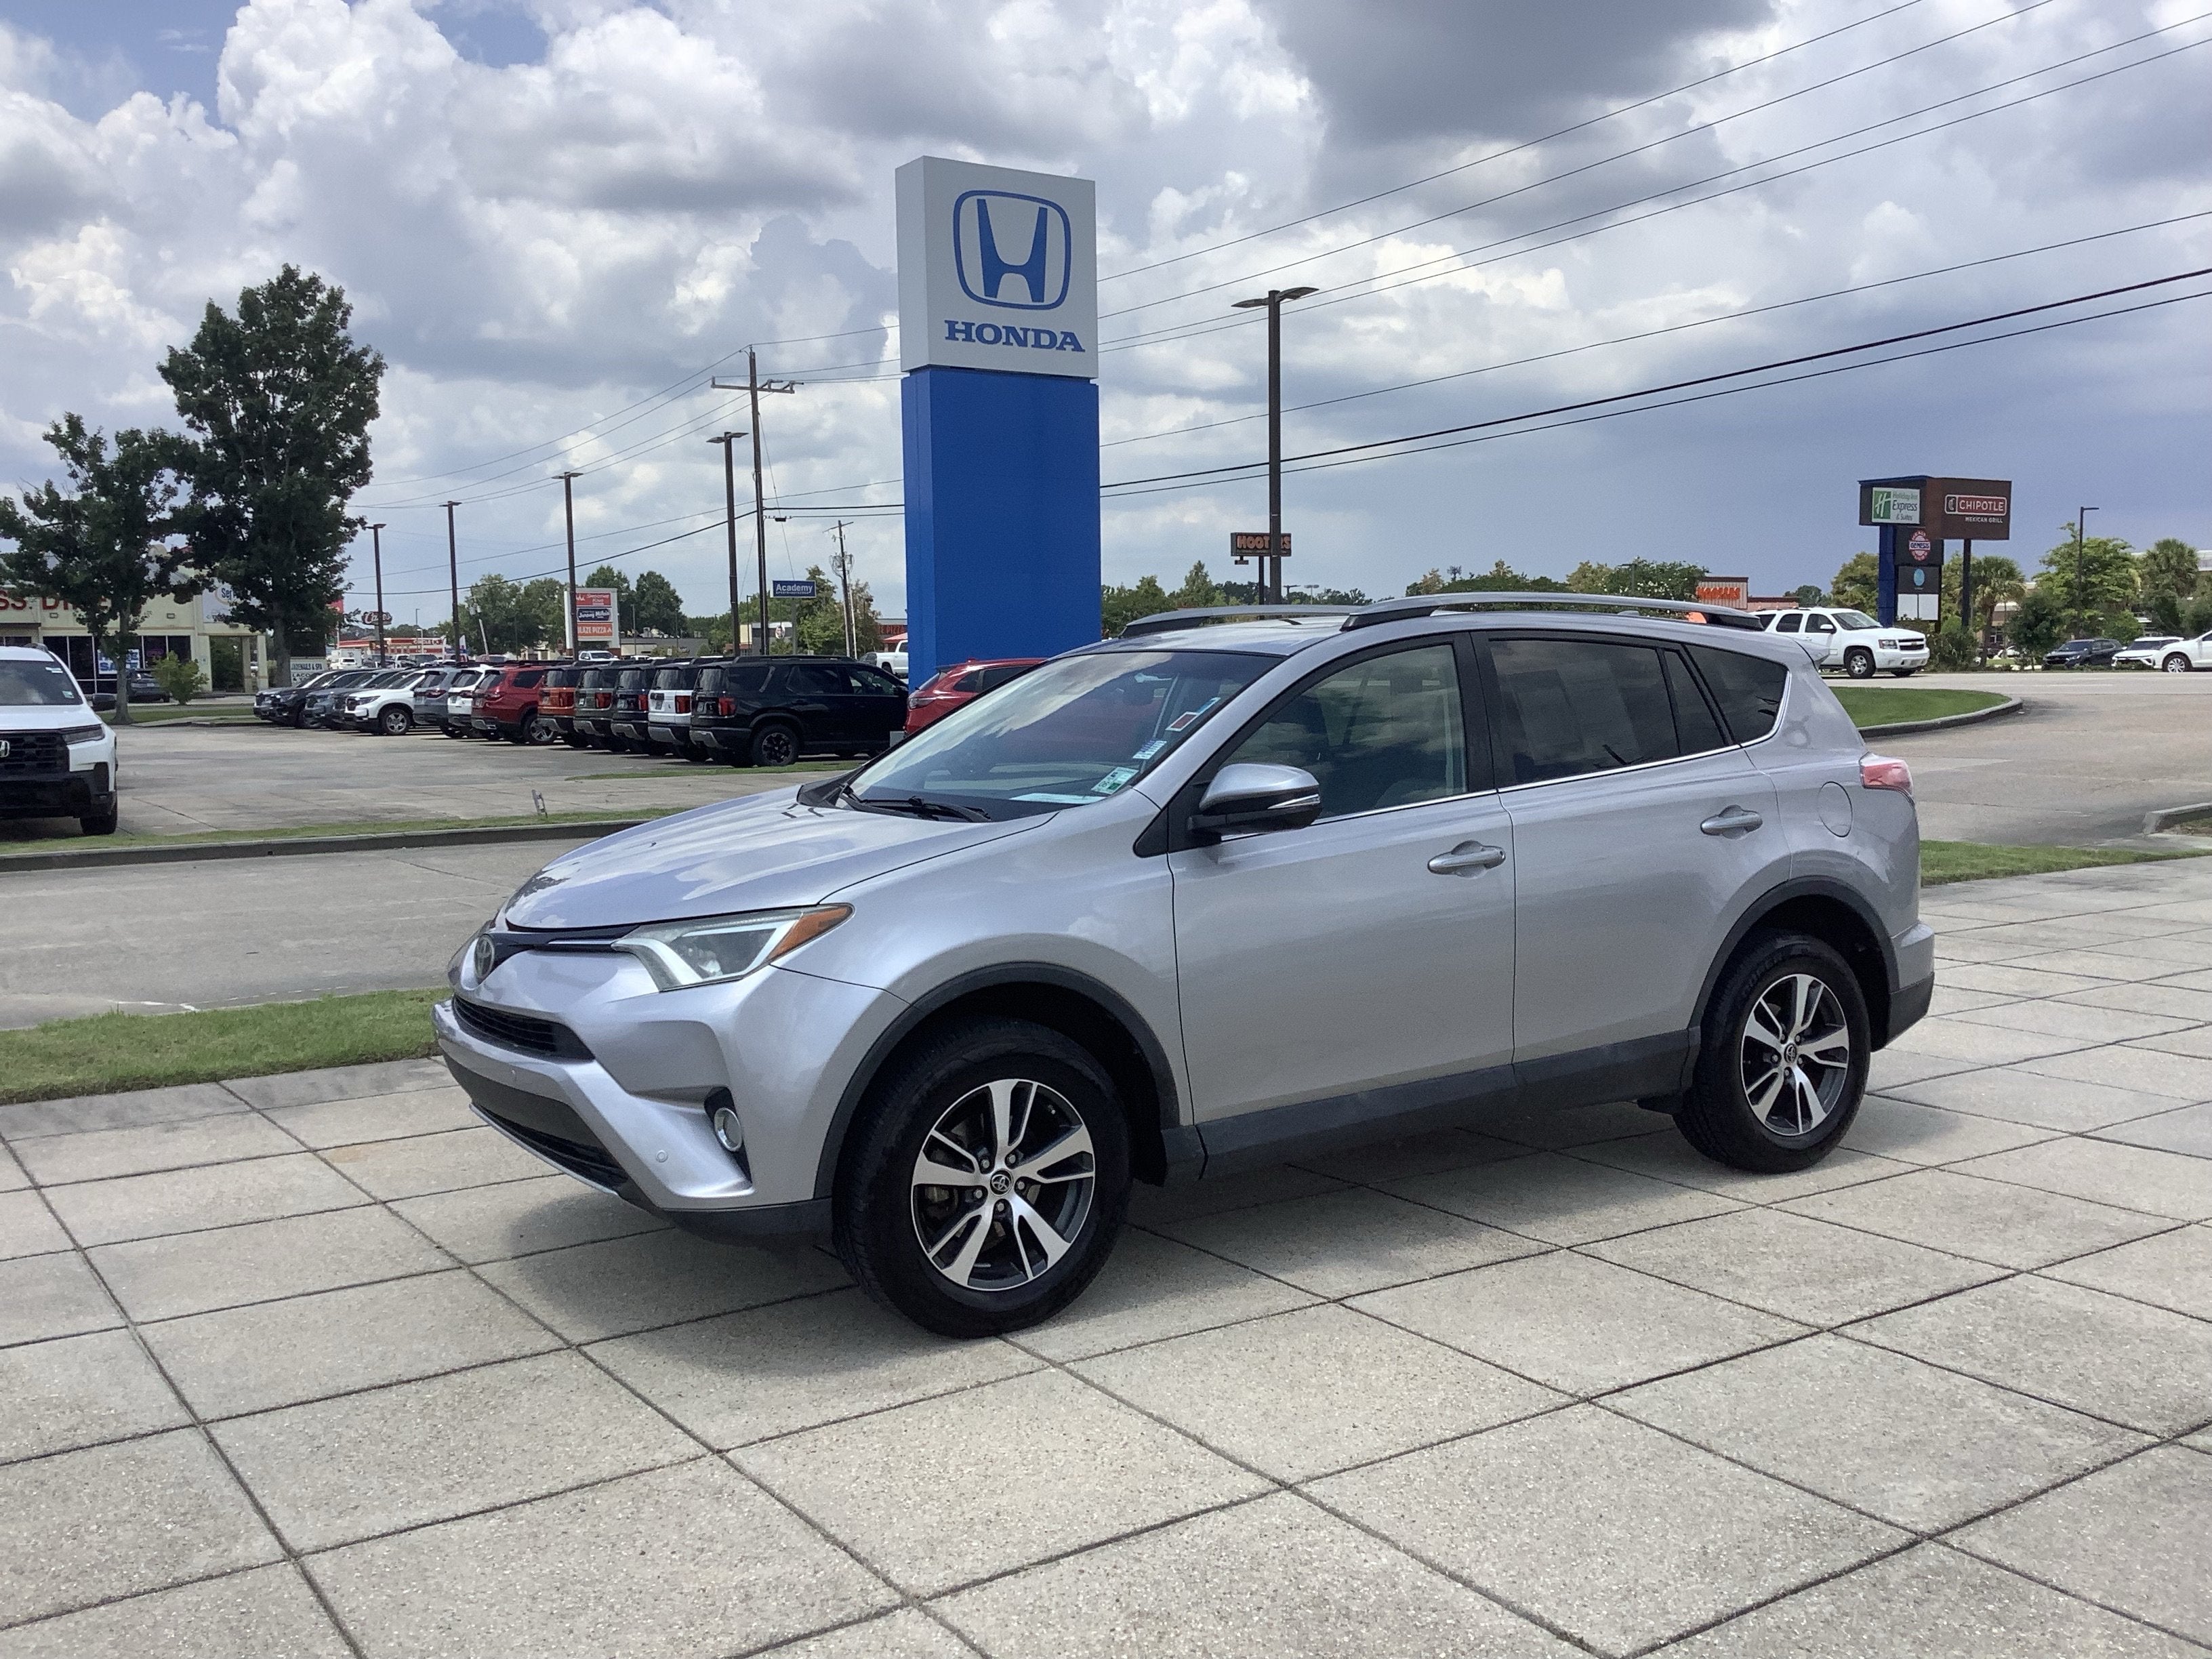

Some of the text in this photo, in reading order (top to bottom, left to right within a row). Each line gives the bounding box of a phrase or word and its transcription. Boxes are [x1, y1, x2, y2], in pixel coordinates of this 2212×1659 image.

[944, 320, 1086, 352] HONDA
[1892, 499, 1917, 512] Express
[1959, 498, 2004, 512] CHIPOTLE
[1237, 535, 1290, 550] HOOTS
[775, 583, 813, 594] Academy
